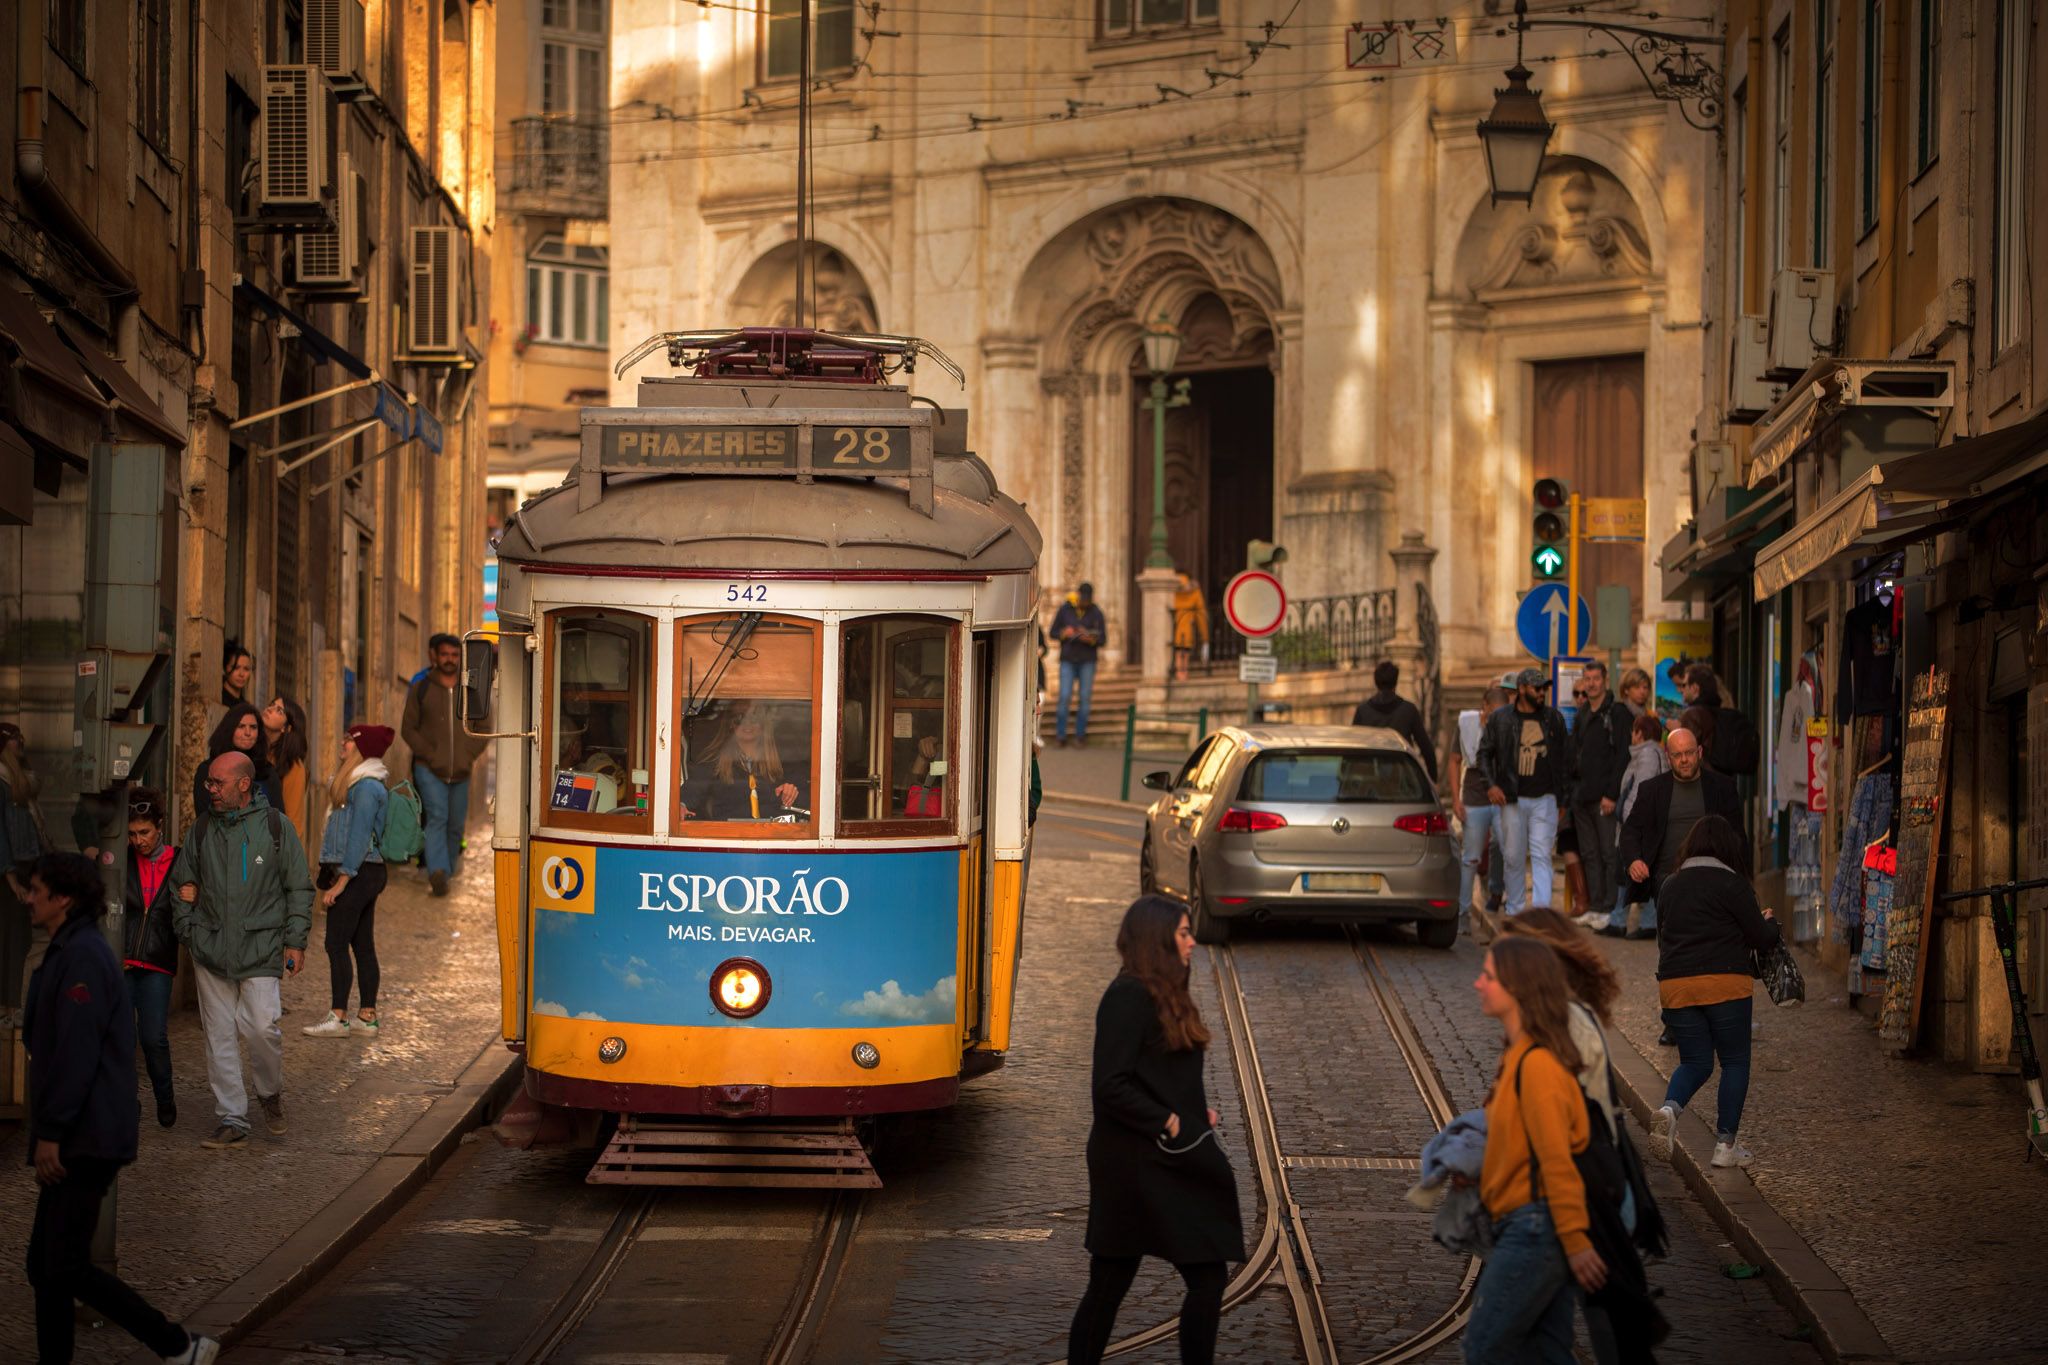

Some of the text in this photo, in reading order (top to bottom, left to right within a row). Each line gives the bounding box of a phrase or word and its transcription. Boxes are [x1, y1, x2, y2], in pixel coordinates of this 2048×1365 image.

[1361, 32, 1385, 55] 10
[618, 431, 786, 457] PRAZERES
[832, 427, 891, 464] 28
[727, 584, 768, 602] 542
[558, 777, 574, 787] 28E
[555, 793, 569, 805] 14
[637, 868, 849, 915] ESPORÃO
[668, 925, 816, 943] MAIS. DEVAGAR.
